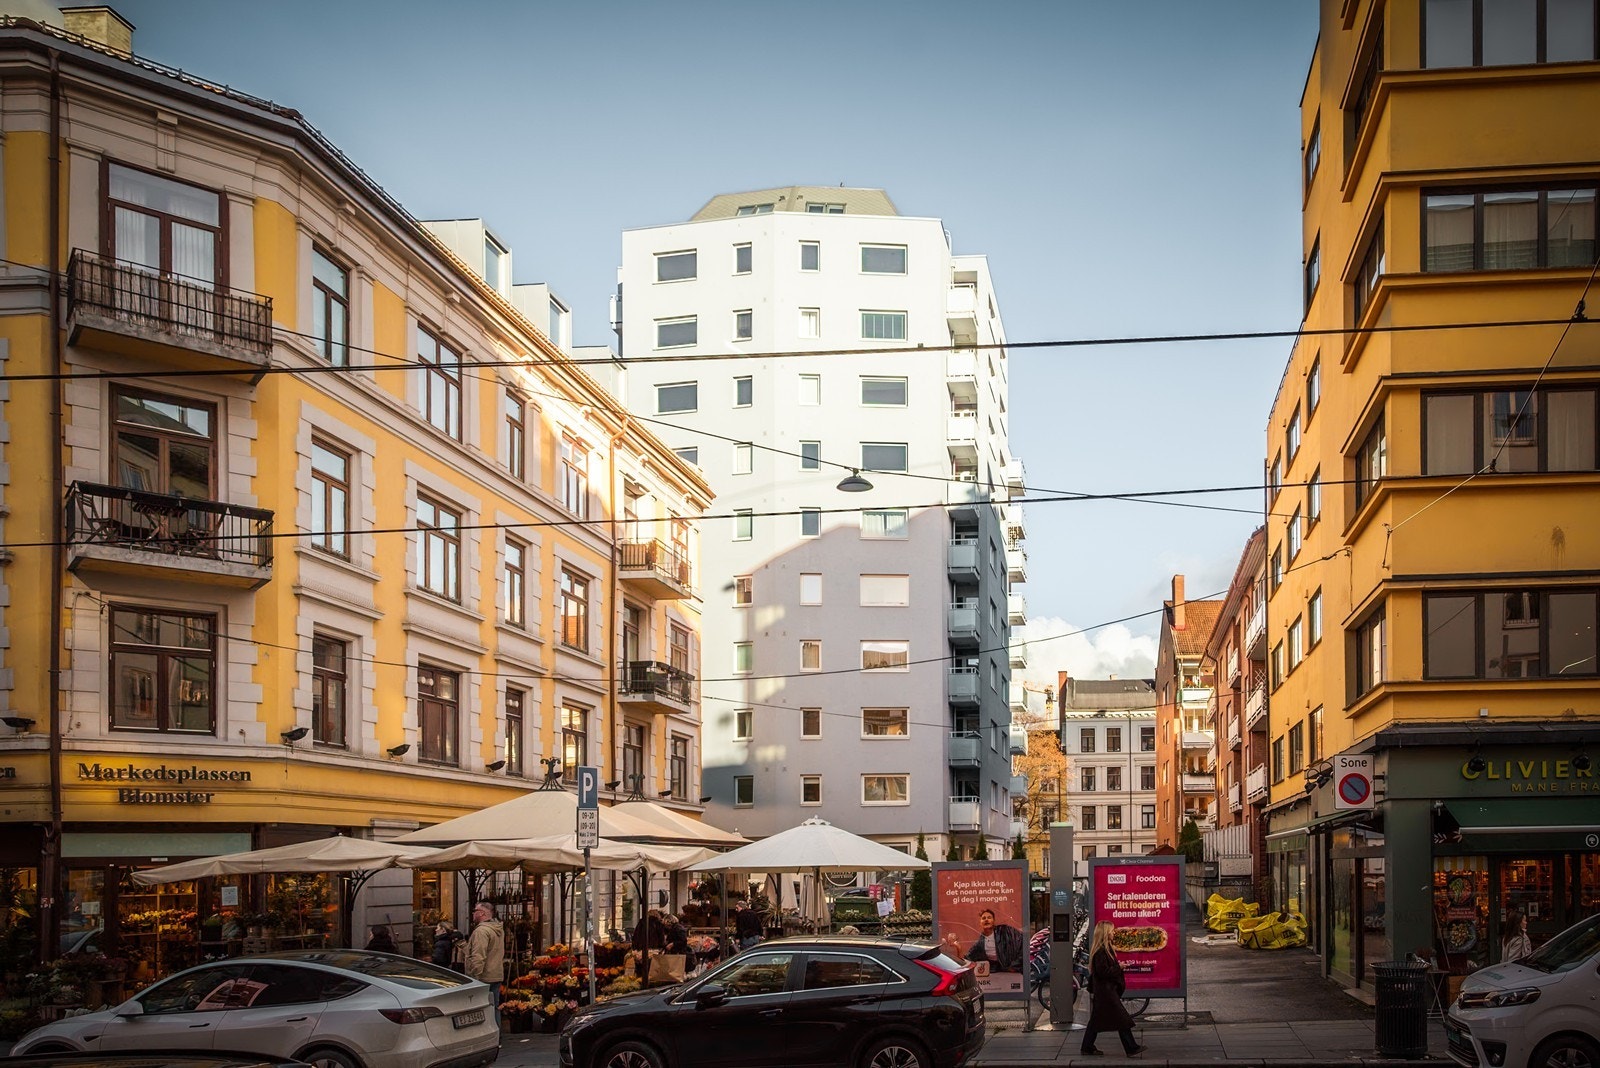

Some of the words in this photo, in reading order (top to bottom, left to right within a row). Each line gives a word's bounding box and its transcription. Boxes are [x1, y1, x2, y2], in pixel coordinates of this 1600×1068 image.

[1341, 758, 1367, 767] Sone
[78, 763, 251, 784] Markedsplassen
[583, 773, 593, 803] P
[118, 788, 215, 804] Blomster
[953, 881, 970, 889] Kjøp
[1107, 892, 1121, 900] Ser
[1122, 892, 1166, 900] kalenderen
[1104, 901, 1116, 909] din
[1117, 901, 1129, 909] litt
[1129, 901, 1160, 909] foodora
[1112, 910, 1136, 918] denne
[1137, 909, 1161, 918] uken?
